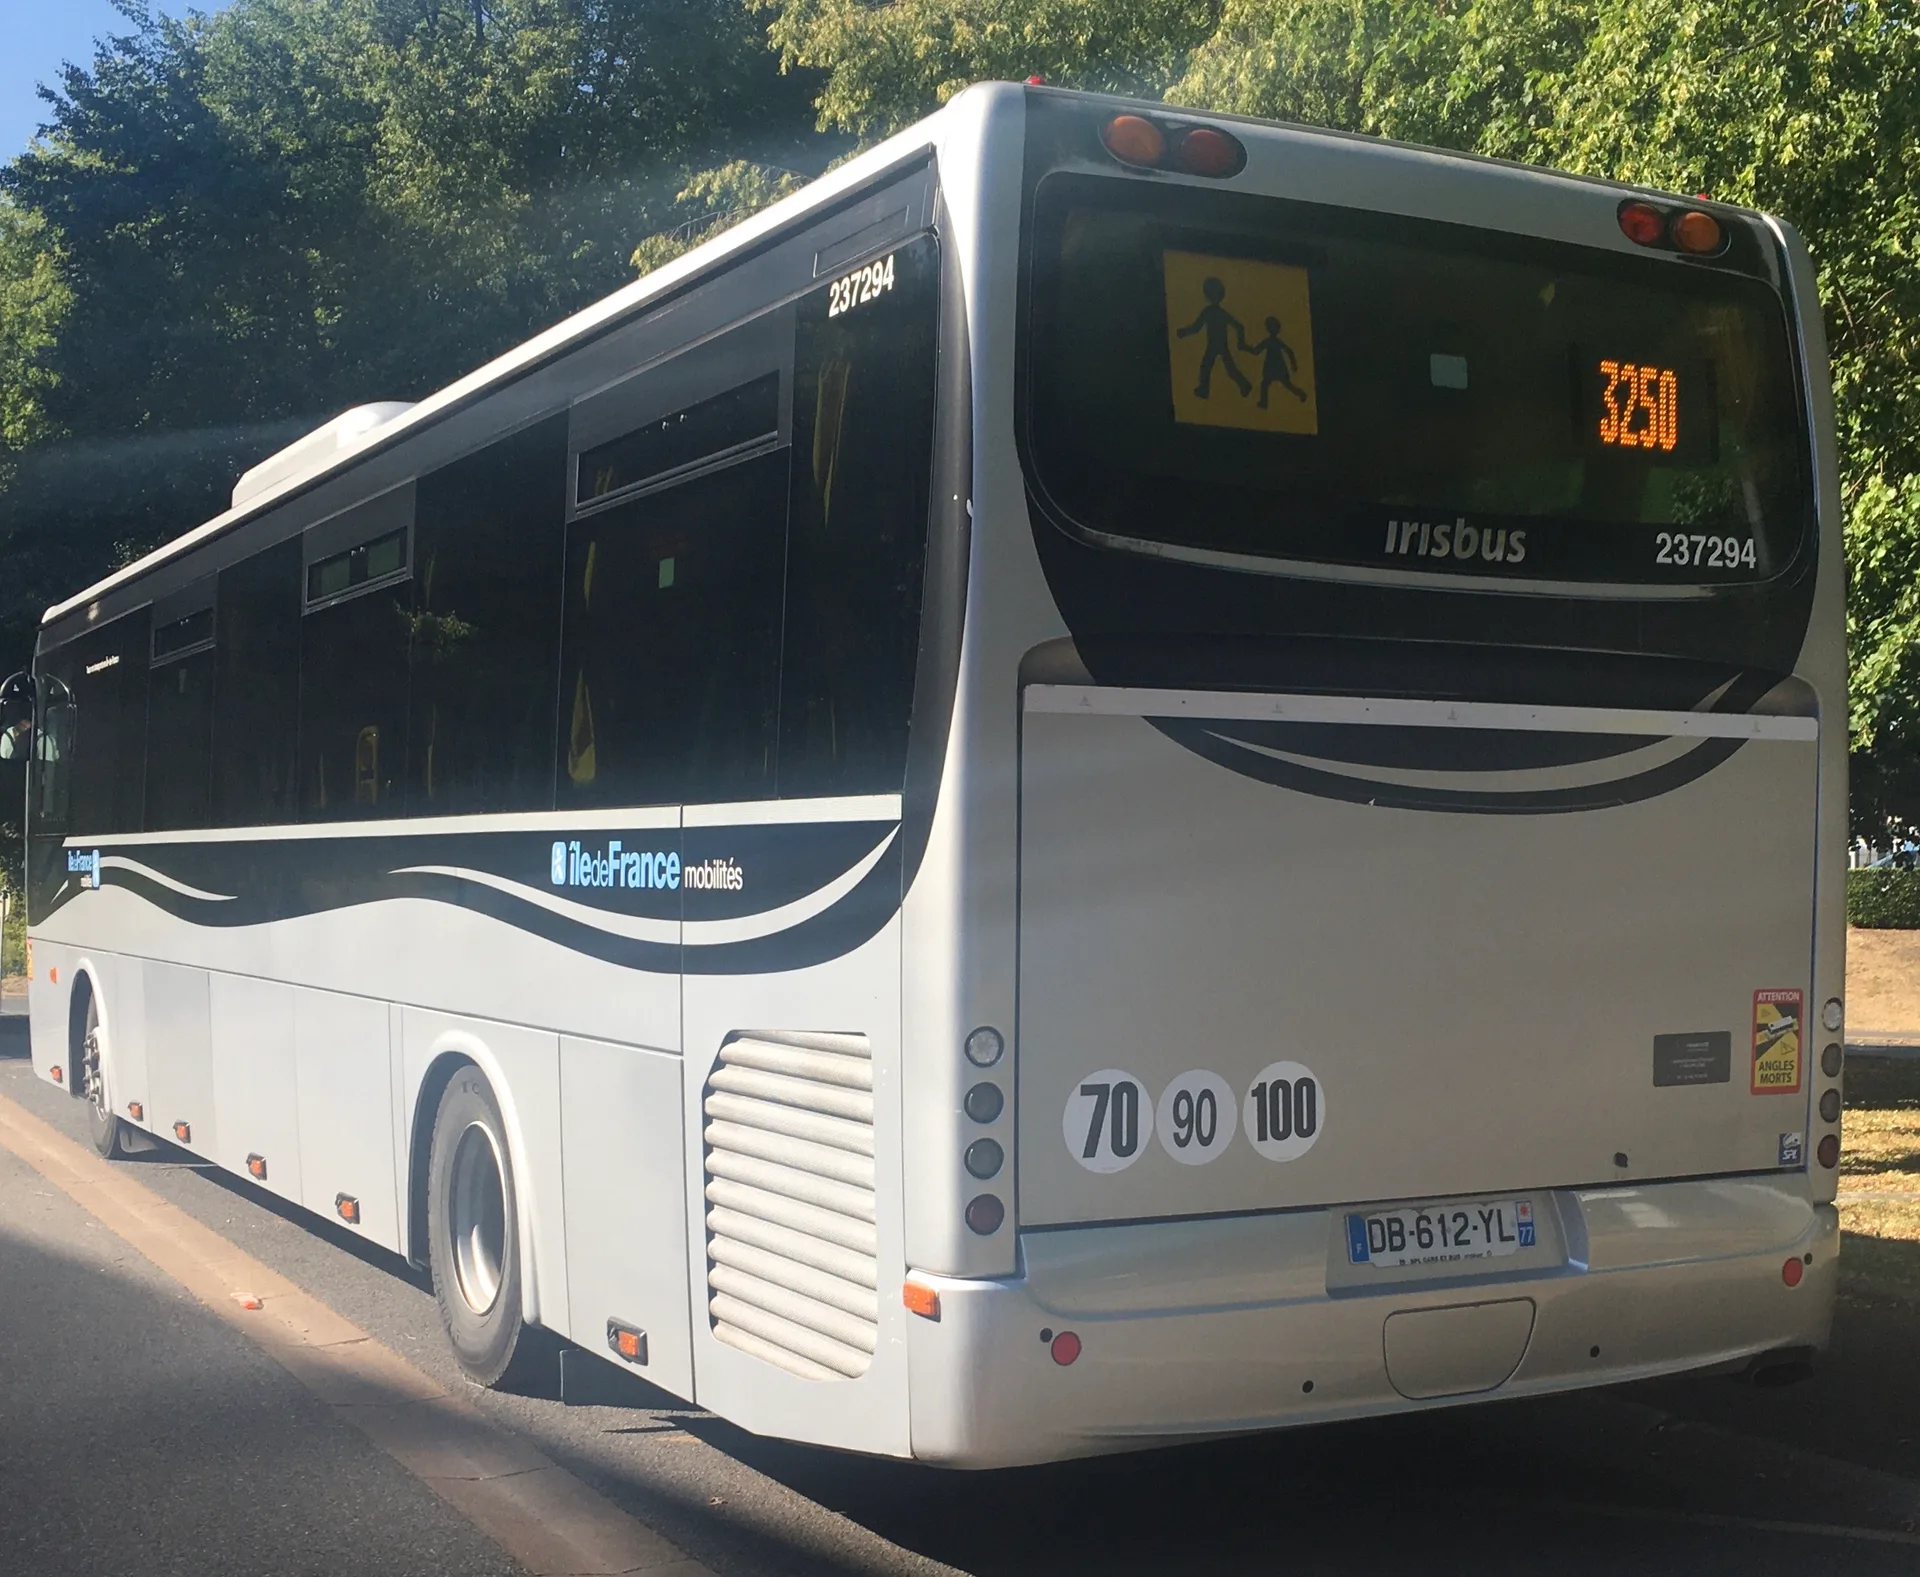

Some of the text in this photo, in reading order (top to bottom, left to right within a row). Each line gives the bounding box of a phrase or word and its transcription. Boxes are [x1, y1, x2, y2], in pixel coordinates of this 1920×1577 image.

[828, 254, 895, 318] 237294
[1600, 359, 1677, 452] 3250
[1655, 532, 1757, 569] 237294
[684, 857, 743, 890] mobilités
[1757, 991, 1800, 1002] ATTENTION
[1758, 1060, 1795, 1072] ANGLES
[1760, 1072, 1792, 1084] MORTS
[1080, 1081, 1139, 1159] 70
[1172, 1088, 1217, 1148] 90
[1251, 1077, 1317, 1142] 100
[1367, 1208, 1516, 1254] DB-612-YL
[1519, 1226, 1534, 1244] 77
